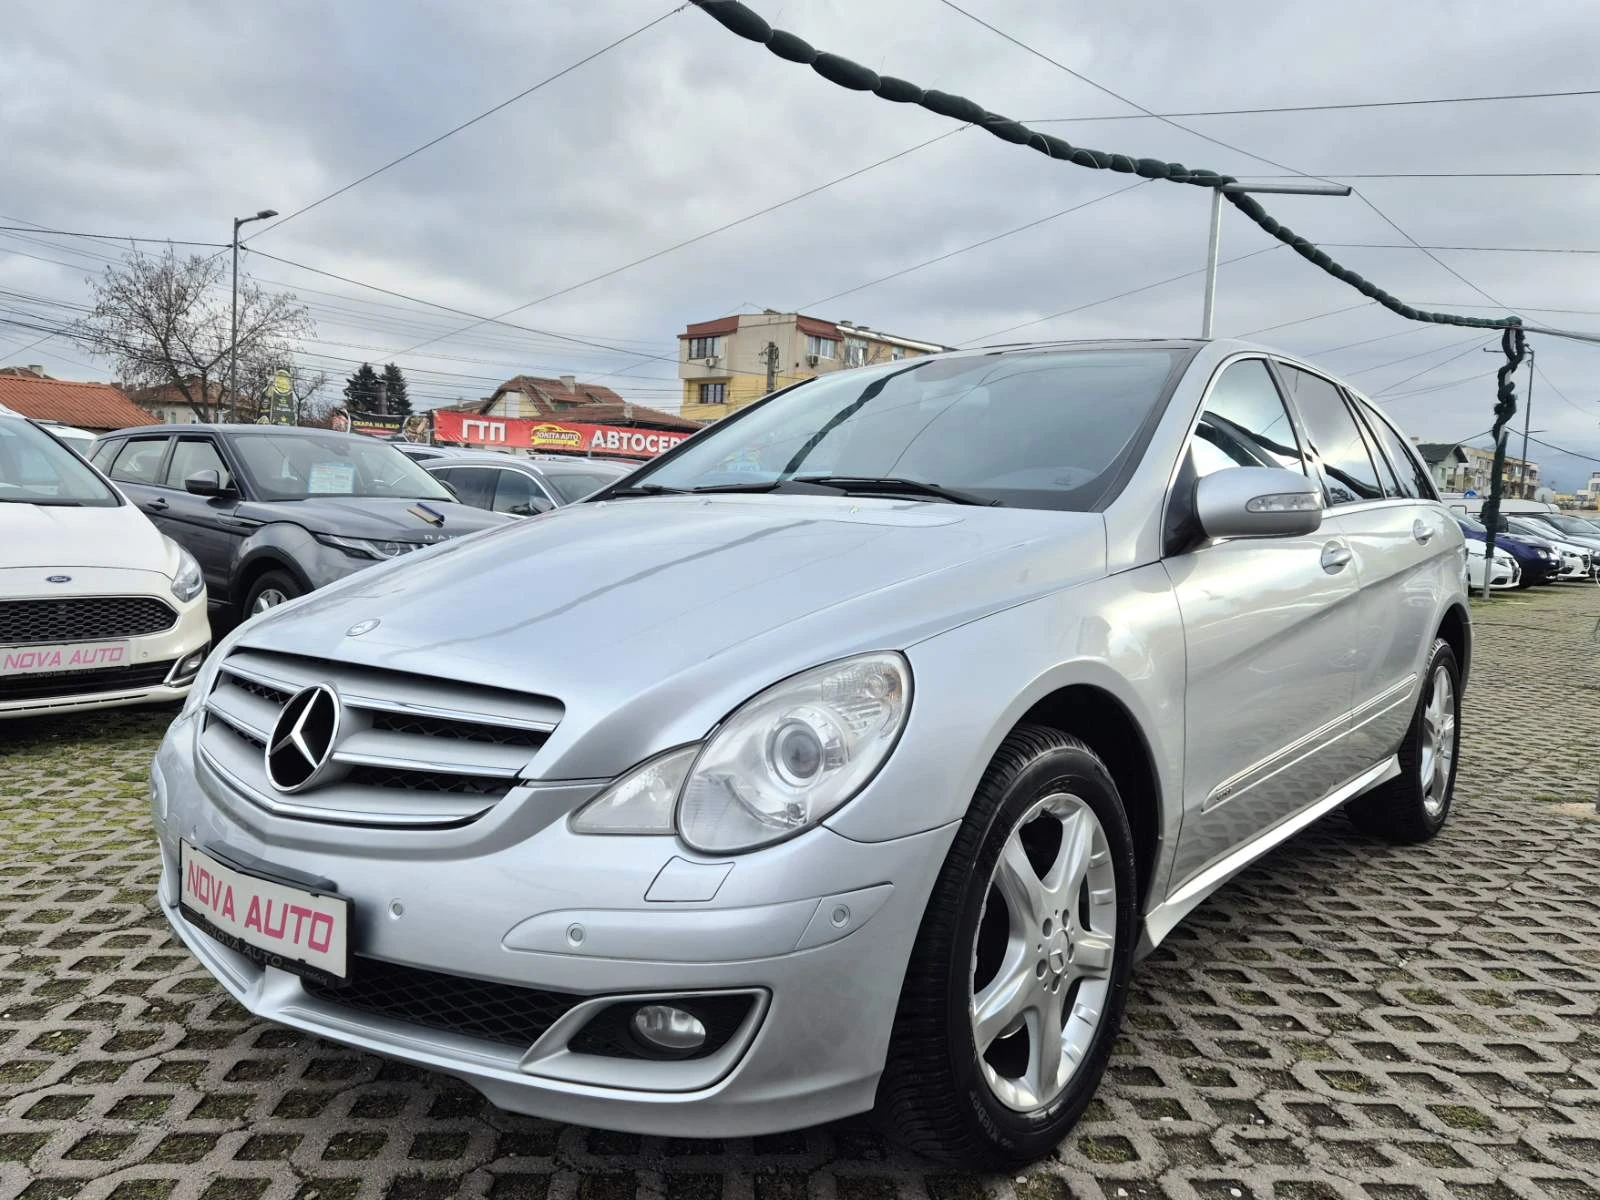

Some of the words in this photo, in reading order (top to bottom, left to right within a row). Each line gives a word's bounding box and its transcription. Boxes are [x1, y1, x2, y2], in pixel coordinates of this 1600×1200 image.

[462, 419, 506, 442] ГТП
[591, 429, 689, 454] АВТОСЕР
[3, 650, 62, 671] NOVA
[69, 646, 125, 665] AUTO
[187, 859, 236, 923] NOVA
[243, 895, 335, 954] AUTO
[243, 945, 283, 967] AUTO
